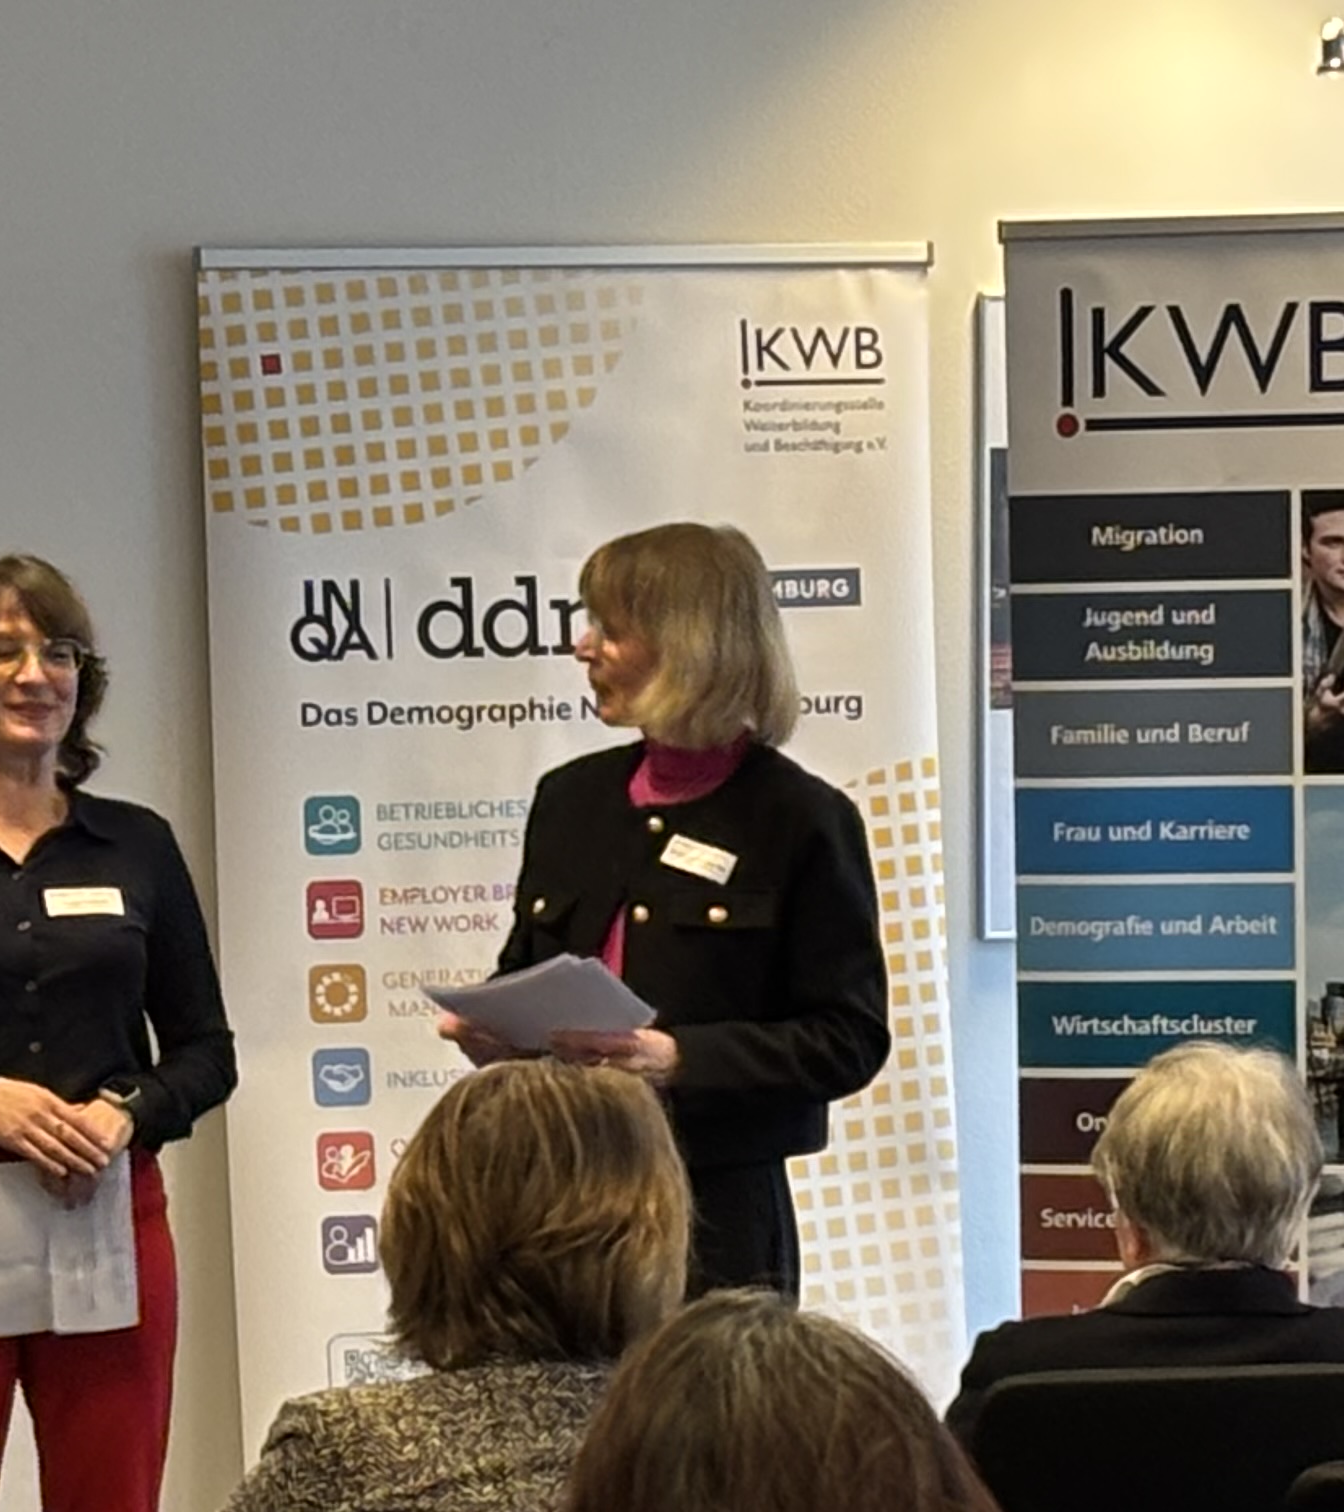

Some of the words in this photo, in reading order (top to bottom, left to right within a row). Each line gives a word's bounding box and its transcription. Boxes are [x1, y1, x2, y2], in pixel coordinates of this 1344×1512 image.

[1091, 523, 1204, 551] Migration
[1082, 604, 1164, 633] Jugend
[1172, 604, 1216, 625] und
[1084, 640, 1215, 665] Ausbildung
[300, 702, 358, 727] Das
[367, 696, 572, 730] Demographie
[1050, 723, 1129, 745] Familie
[1136, 722, 1180, 743] und
[1188, 721, 1251, 743] Beruf
[376, 800, 528, 821] BETRIEBLICHES
[1053, 821, 1101, 842] Frau
[1108, 820, 1152, 841] und
[1159, 819, 1251, 841] Karriere
[379, 884, 487, 905] EMPLOYER
[380, 916, 429, 935] NEW
[434, 914, 499, 933] WORK
[1030, 915, 1154, 942] Demografie
[1160, 915, 1203, 935] und
[1209, 914, 1278, 934] Arbeit
[1052, 1014, 1257, 1036] Wirtschaftscluster
